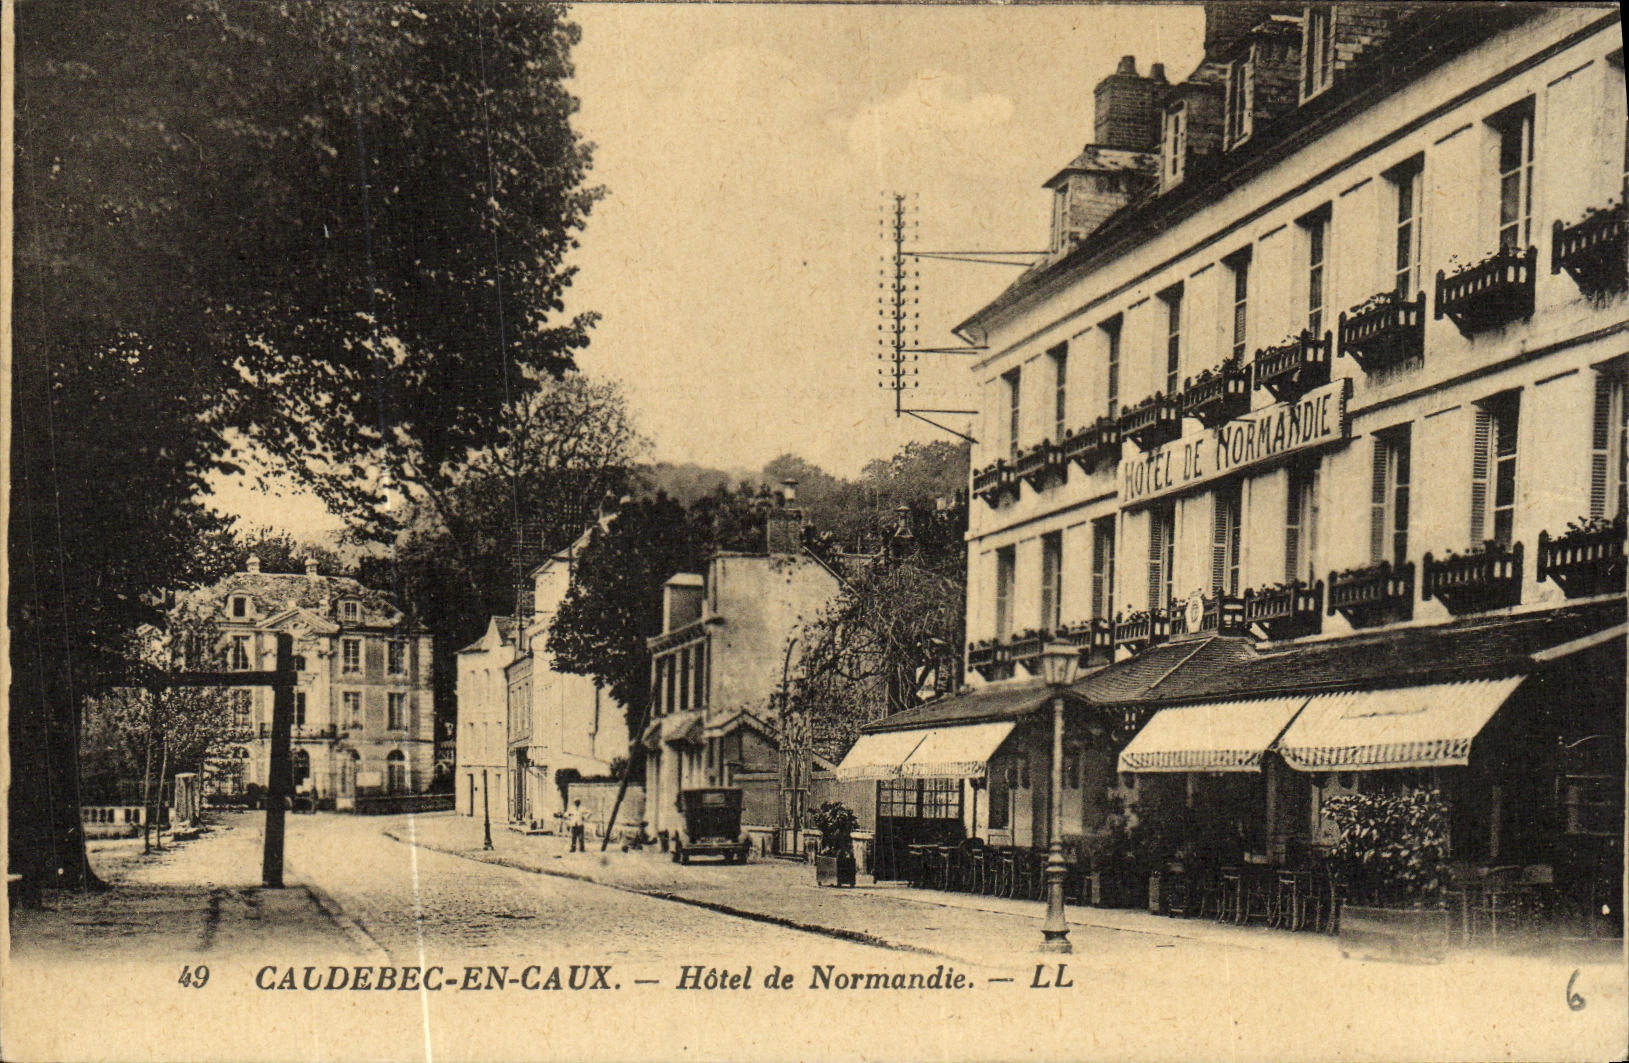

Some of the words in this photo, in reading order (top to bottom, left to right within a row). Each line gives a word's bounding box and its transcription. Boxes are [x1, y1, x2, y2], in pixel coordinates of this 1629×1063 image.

[1124, 450, 1173, 502] HOTEL
[1183, 439, 1204, 481] DE
[1216, 393, 1332, 471] NORMANDIE
[1566, 968, 1587, 1012] 6
